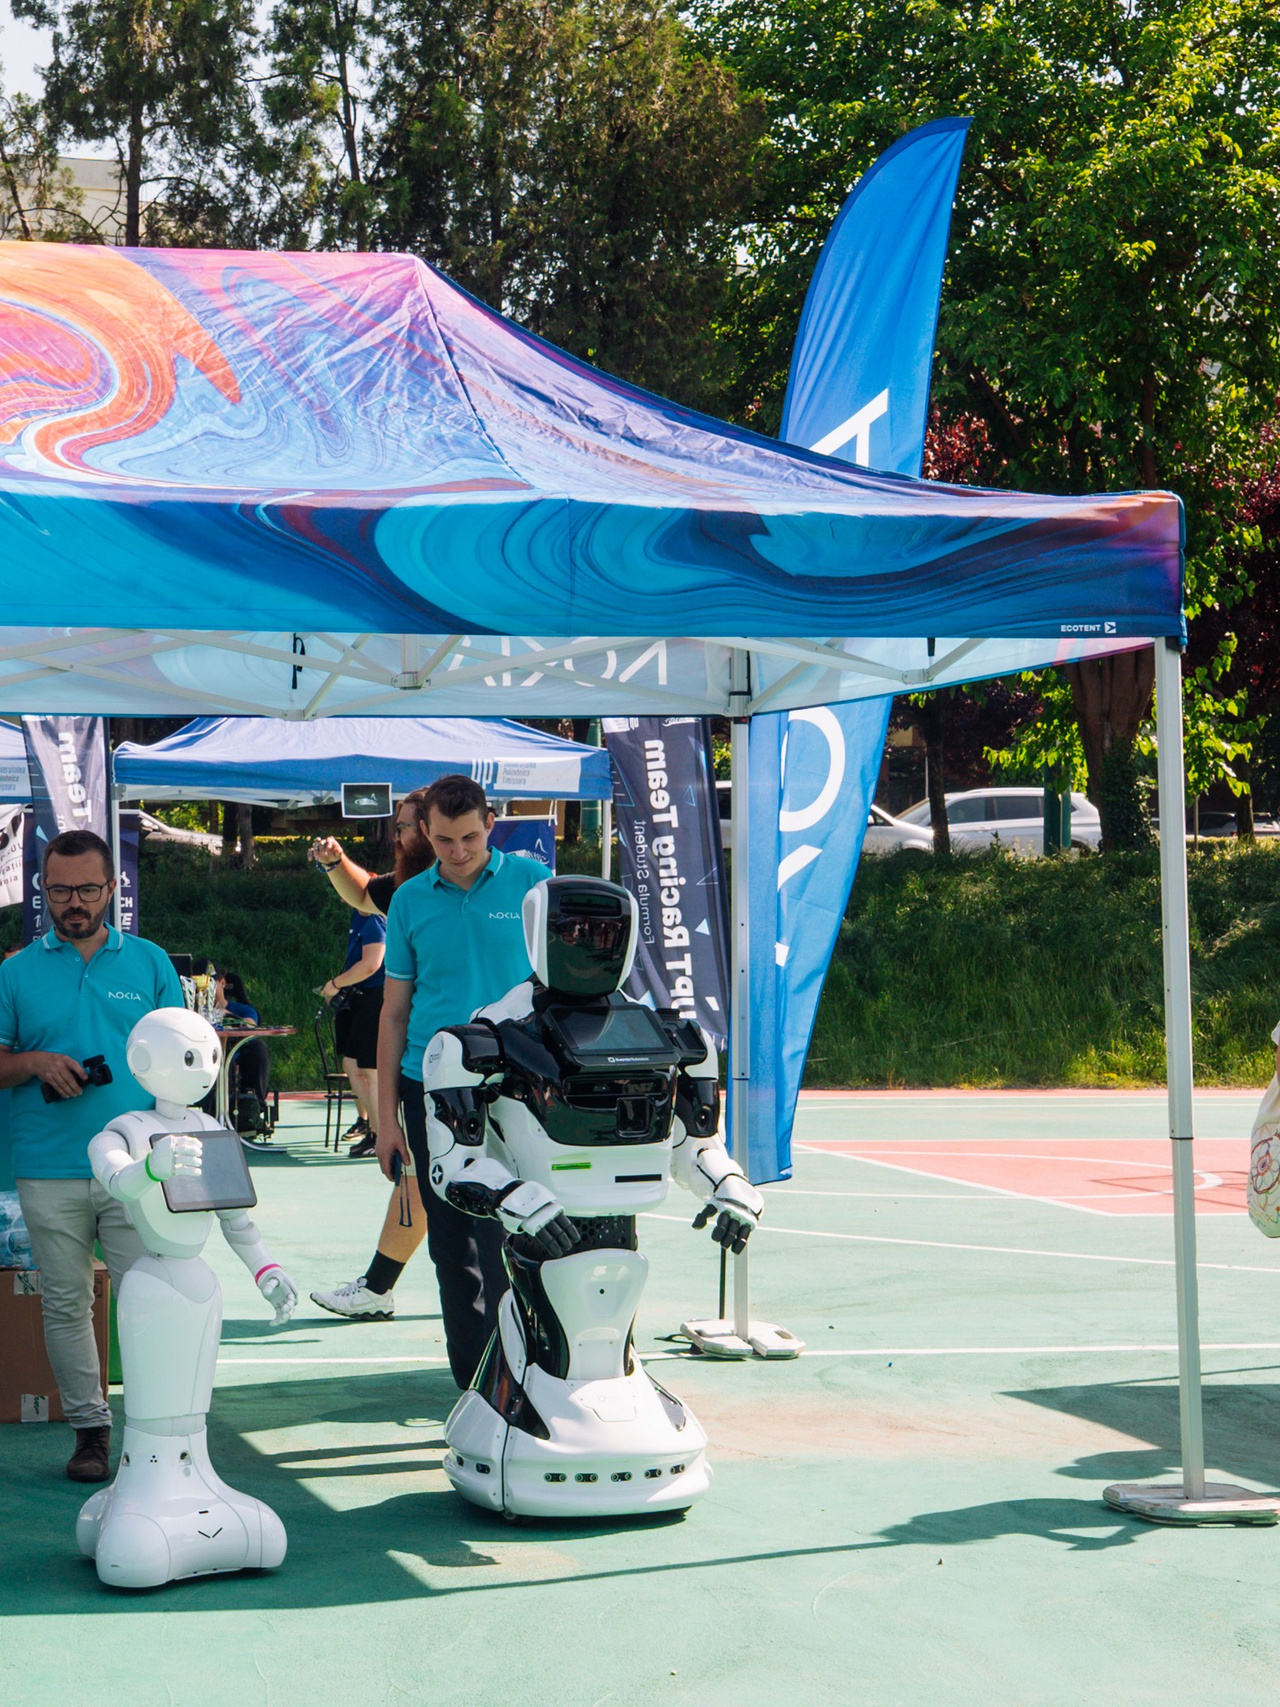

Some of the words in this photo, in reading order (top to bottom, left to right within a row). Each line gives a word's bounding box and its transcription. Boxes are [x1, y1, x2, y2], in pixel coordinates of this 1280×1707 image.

[1060, 624, 1101, 632] ECOTENT
[489, 911, 521, 920] NOKIA
[108, 991, 141, 1001] NOKIA
